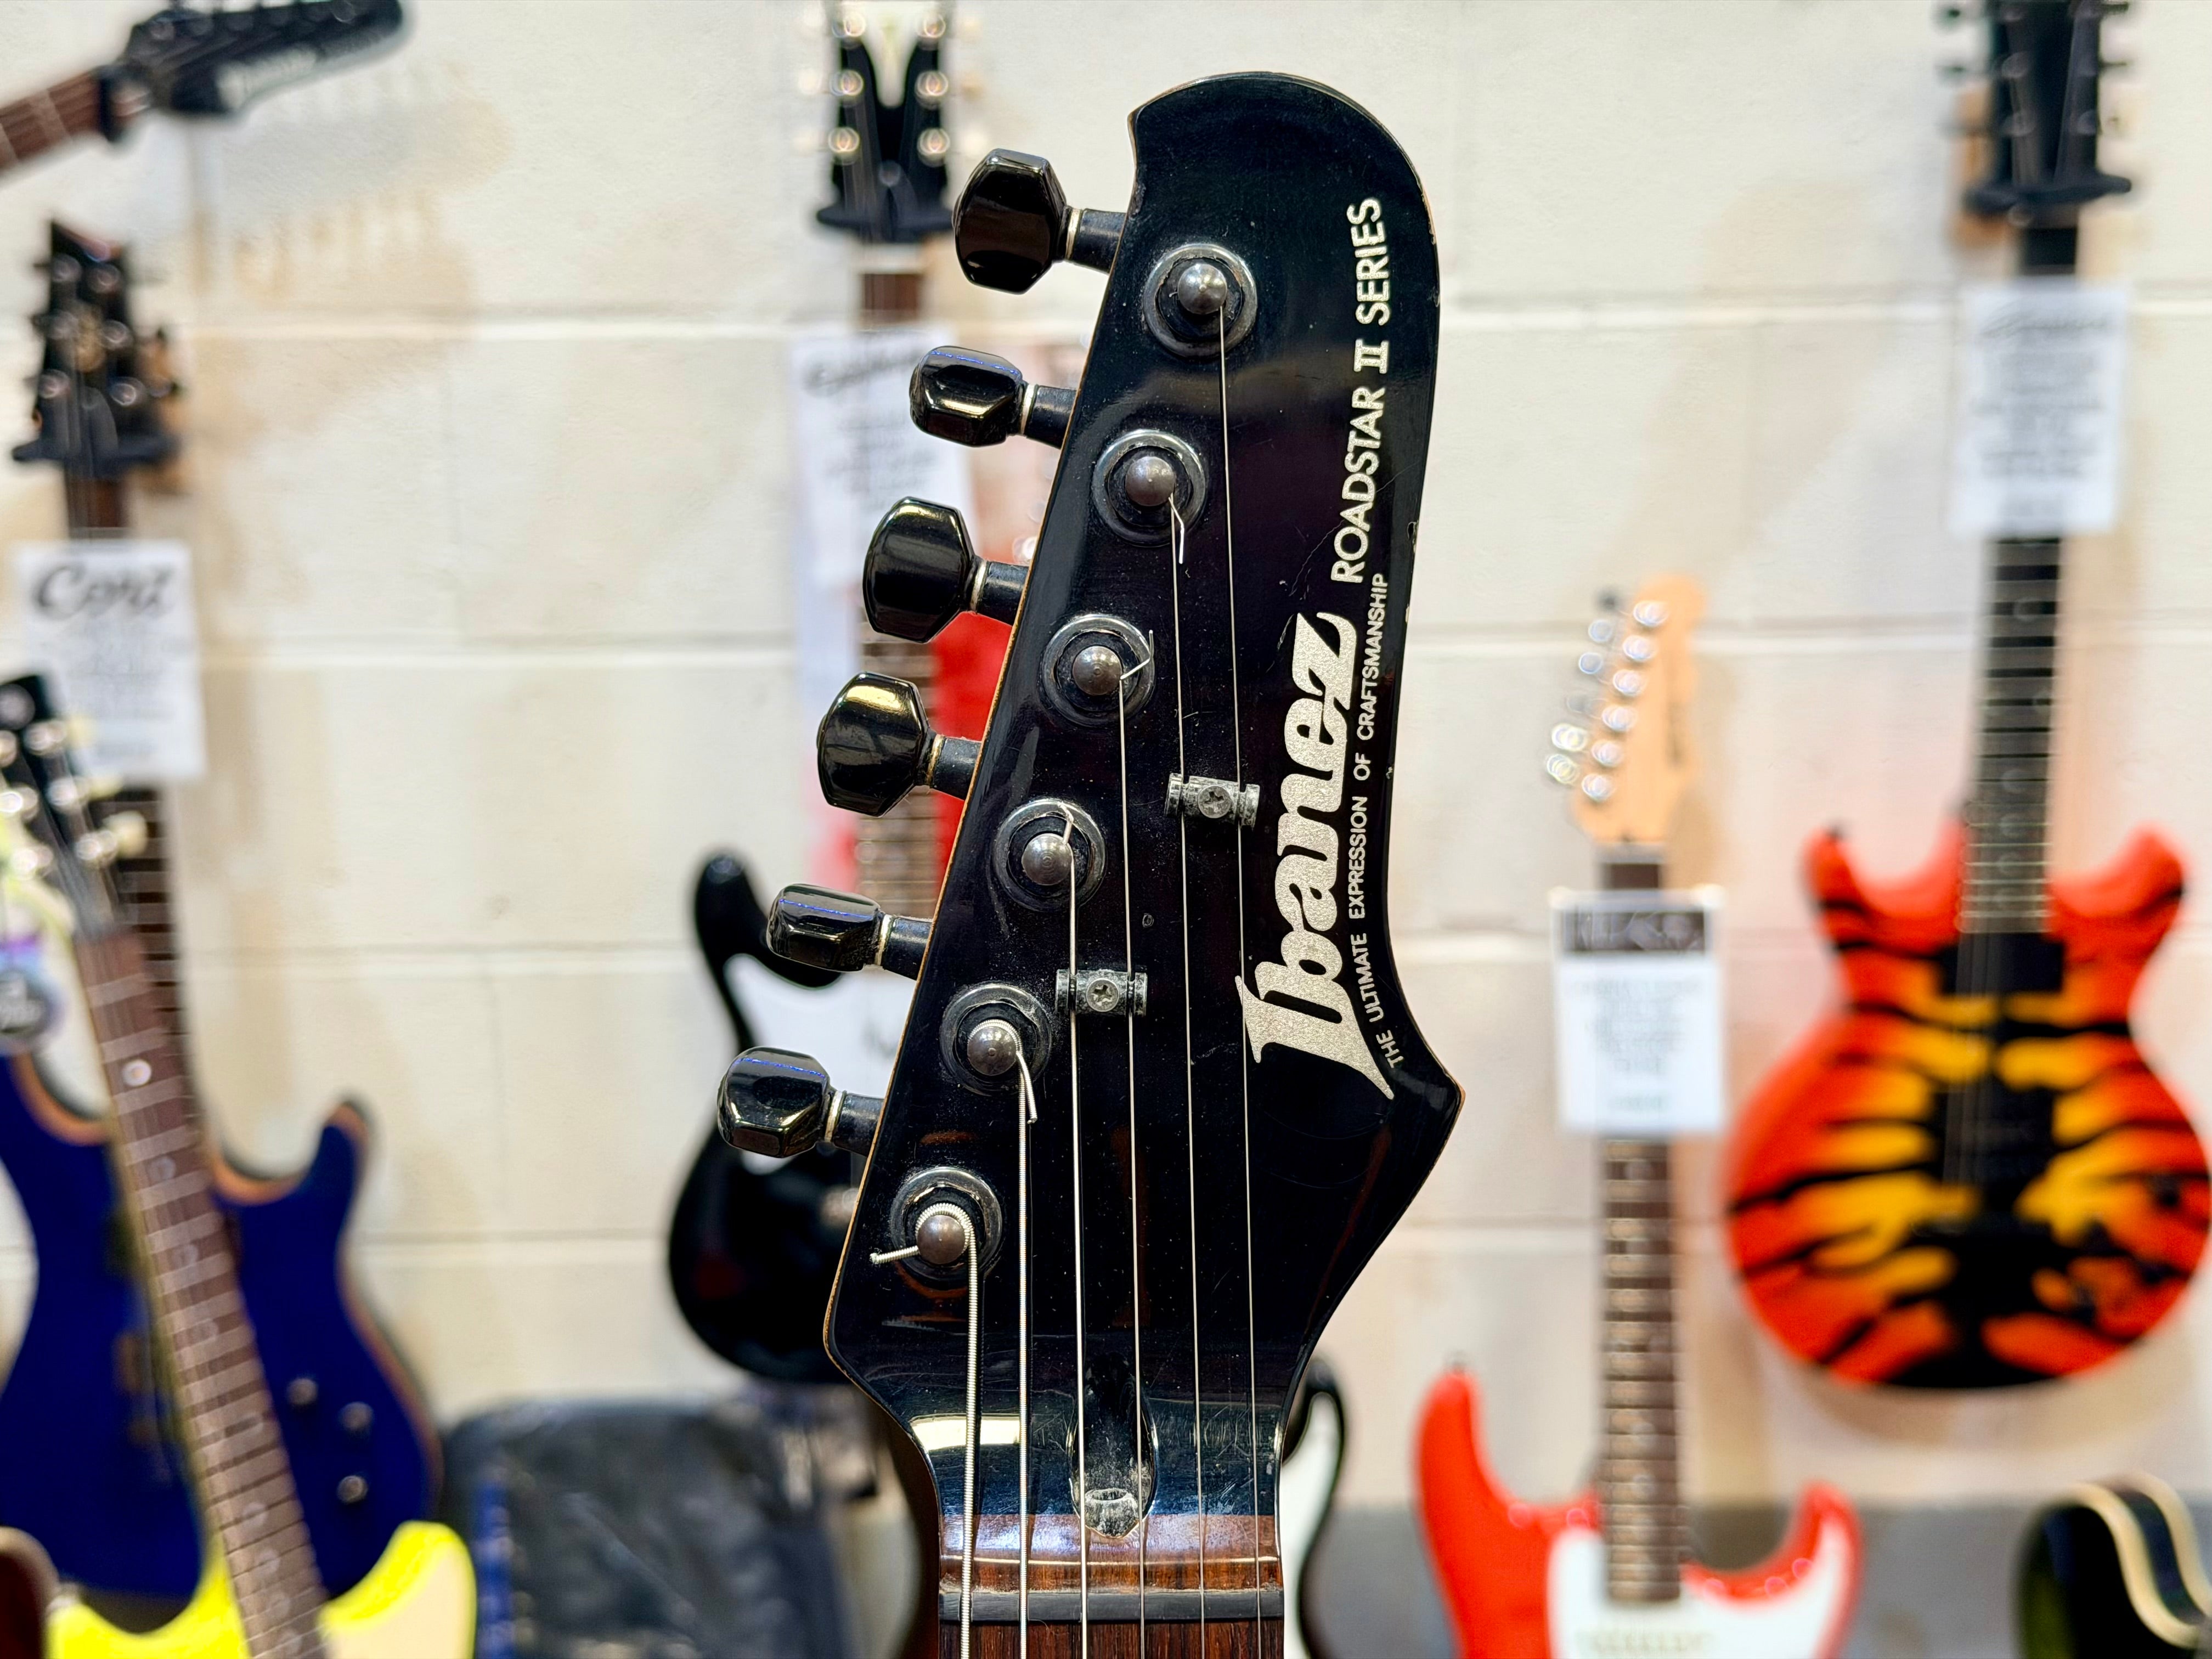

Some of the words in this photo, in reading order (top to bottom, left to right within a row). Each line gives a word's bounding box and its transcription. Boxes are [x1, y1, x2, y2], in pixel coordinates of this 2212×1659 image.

[1346, 198, 1390, 325] SERIES
[1353, 338, 1389, 374] II
[1331, 386, 1385, 583] ROADSTAR
[1357, 573, 1387, 740] CRAFTSMANSHIP
[1353, 752, 1370, 780] OF
[1235, 612, 1394, 1099] Ibanez
[1347, 796, 1367, 919] EXPRESSION
[1350, 933, 1384, 1022] ULTIMATE
[1376, 1030, 1404, 1068] THE
